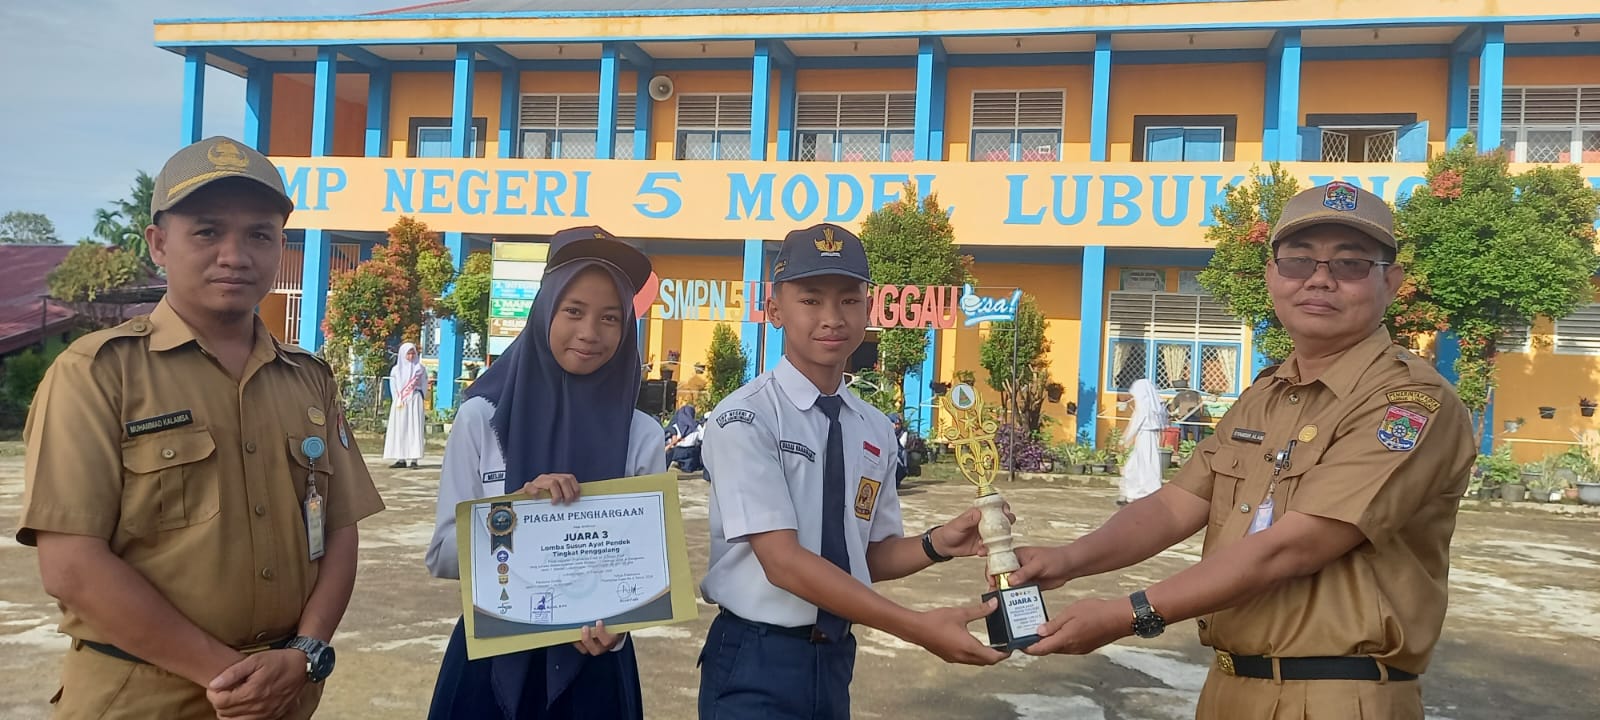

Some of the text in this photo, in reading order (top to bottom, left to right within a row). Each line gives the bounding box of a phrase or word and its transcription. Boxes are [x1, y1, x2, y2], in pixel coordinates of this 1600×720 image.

[275, 166, 347, 211] MP
[382, 168, 592, 217] NEGERI
[633, 171, 682, 219] 5
[660, 279, 727, 320] SMPN
[730, 281, 744, 321] 5
[523, 507, 644, 523] PIAGAM PENGHARGAAN
[563, 530, 609, 542] JUARA 3
[540, 544, 564, 552] Lomba
[566, 542, 587, 550] Susun
[588, 541, 604, 549] Ayat
[552, 547, 620, 558] Tingkat Penggalang
[1008, 597, 1032, 607] JUARA
